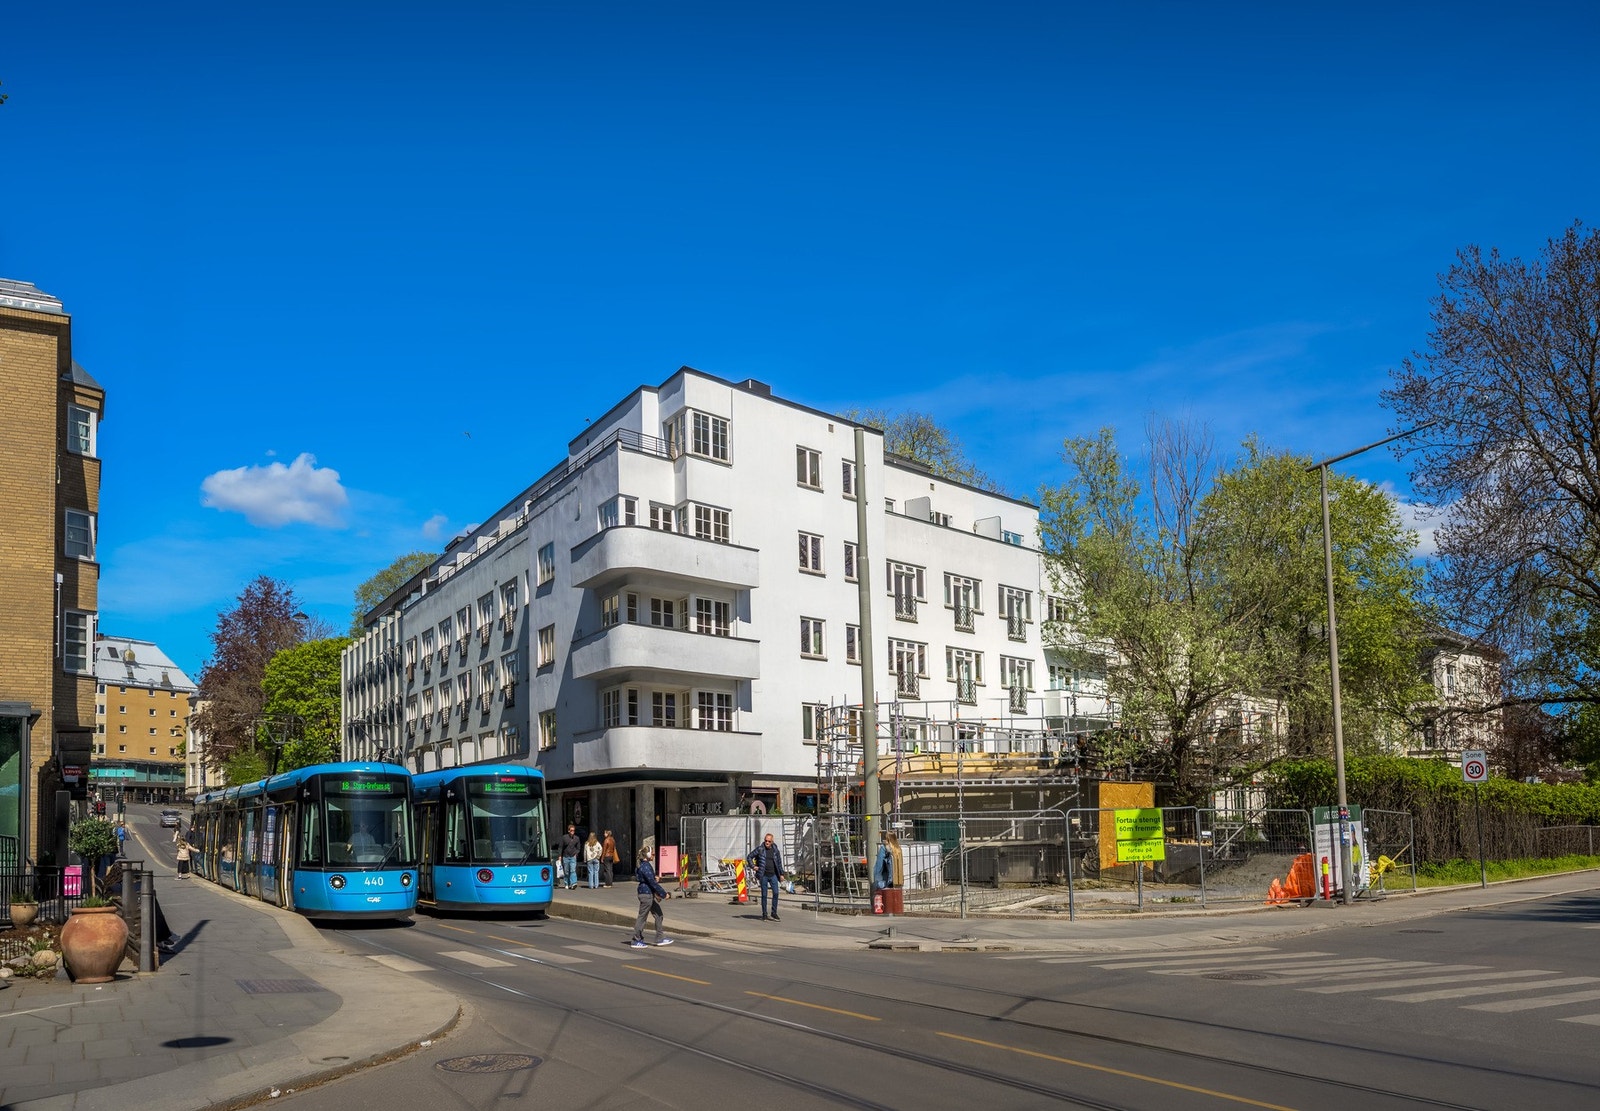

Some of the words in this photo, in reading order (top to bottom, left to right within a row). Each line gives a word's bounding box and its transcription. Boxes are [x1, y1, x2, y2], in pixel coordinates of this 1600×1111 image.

[1469, 765, 1481, 774] 30
[342, 782, 350, 790] 18
[681, 803, 690, 814] JOE
[695, 802, 704, 814] THE
[706, 802, 722, 814] JUICE
[1138, 816, 1160, 824] stengt
[364, 876, 384, 886] 440
[511, 874, 528, 883] 437
